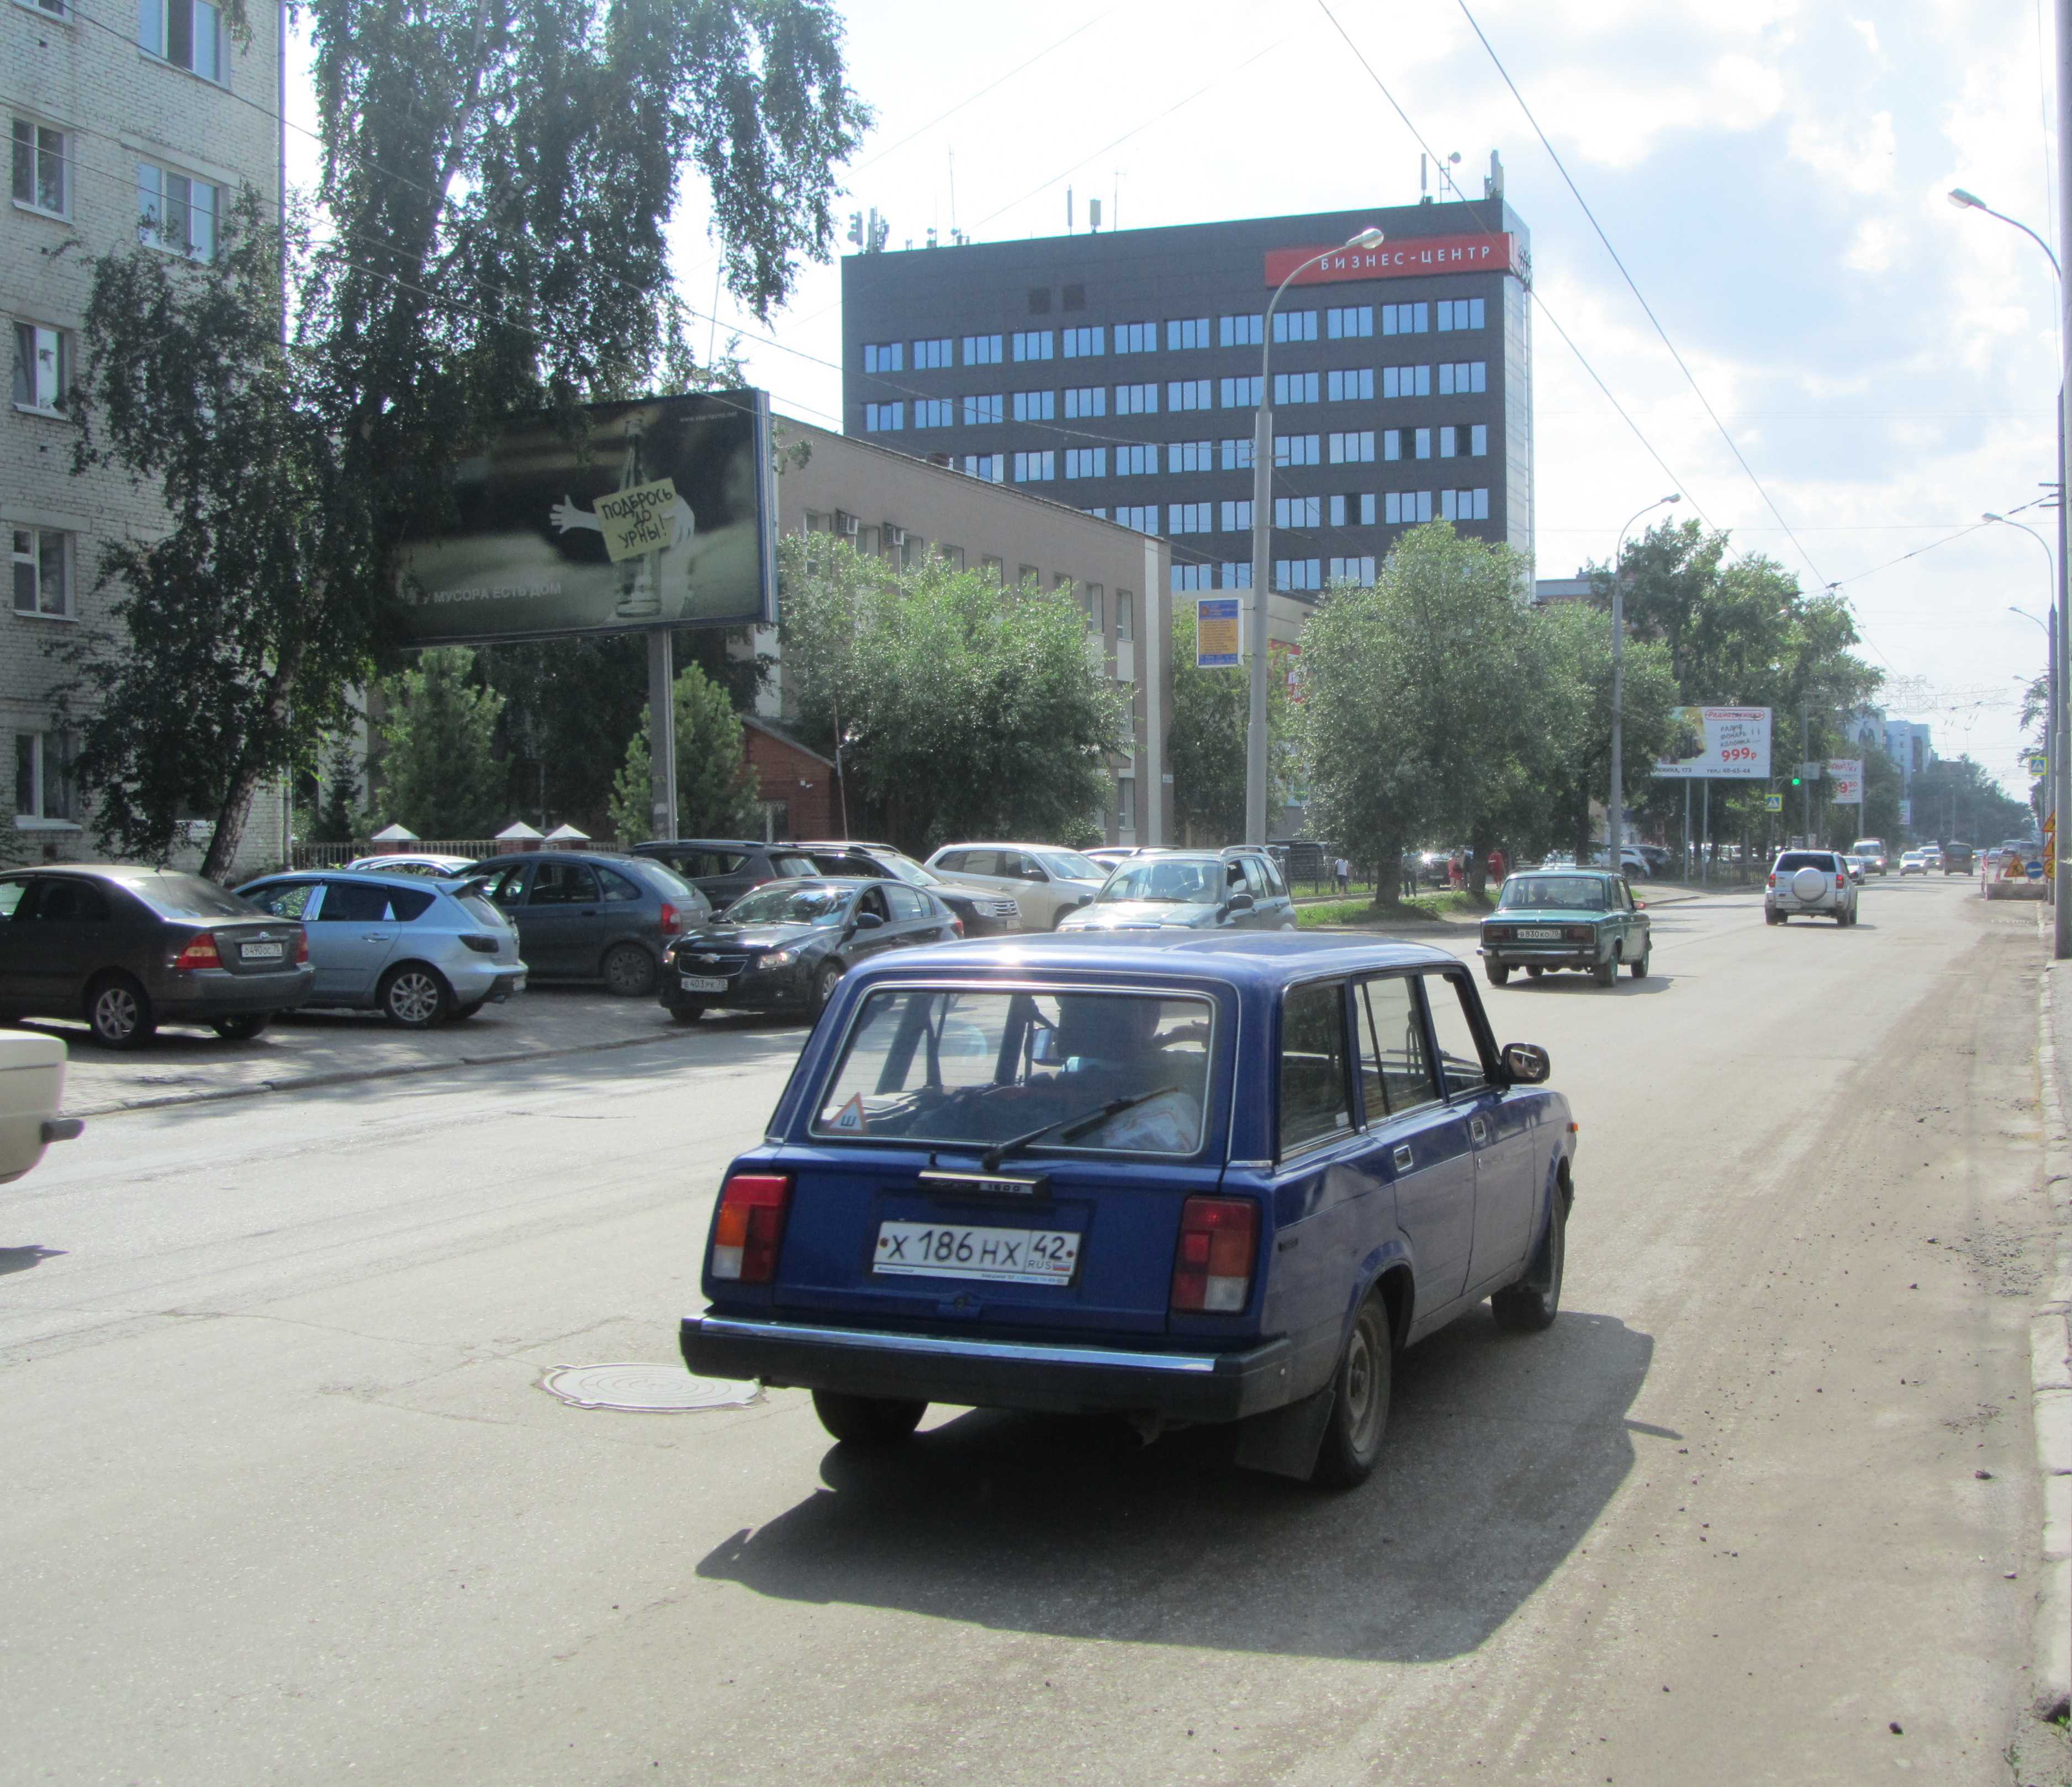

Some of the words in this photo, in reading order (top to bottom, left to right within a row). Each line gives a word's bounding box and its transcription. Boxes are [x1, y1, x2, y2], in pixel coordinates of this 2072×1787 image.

[1320, 246, 1490, 271] БИЗНЕС-ЦЕНТР
[601, 488, 673, 520] ПОДБРОСЬ
[633, 509, 652, 528] ДО
[618, 514, 667, 549] УРНЫ!
[433, 589, 489, 603] МУСОРА
[493, 586, 526, 599] ЕСТЬ
[530, 581, 562, 598] ДОМ
[840, 1115, 858, 1127] Ш
[1027, 1260, 1053, 1271] RUS
